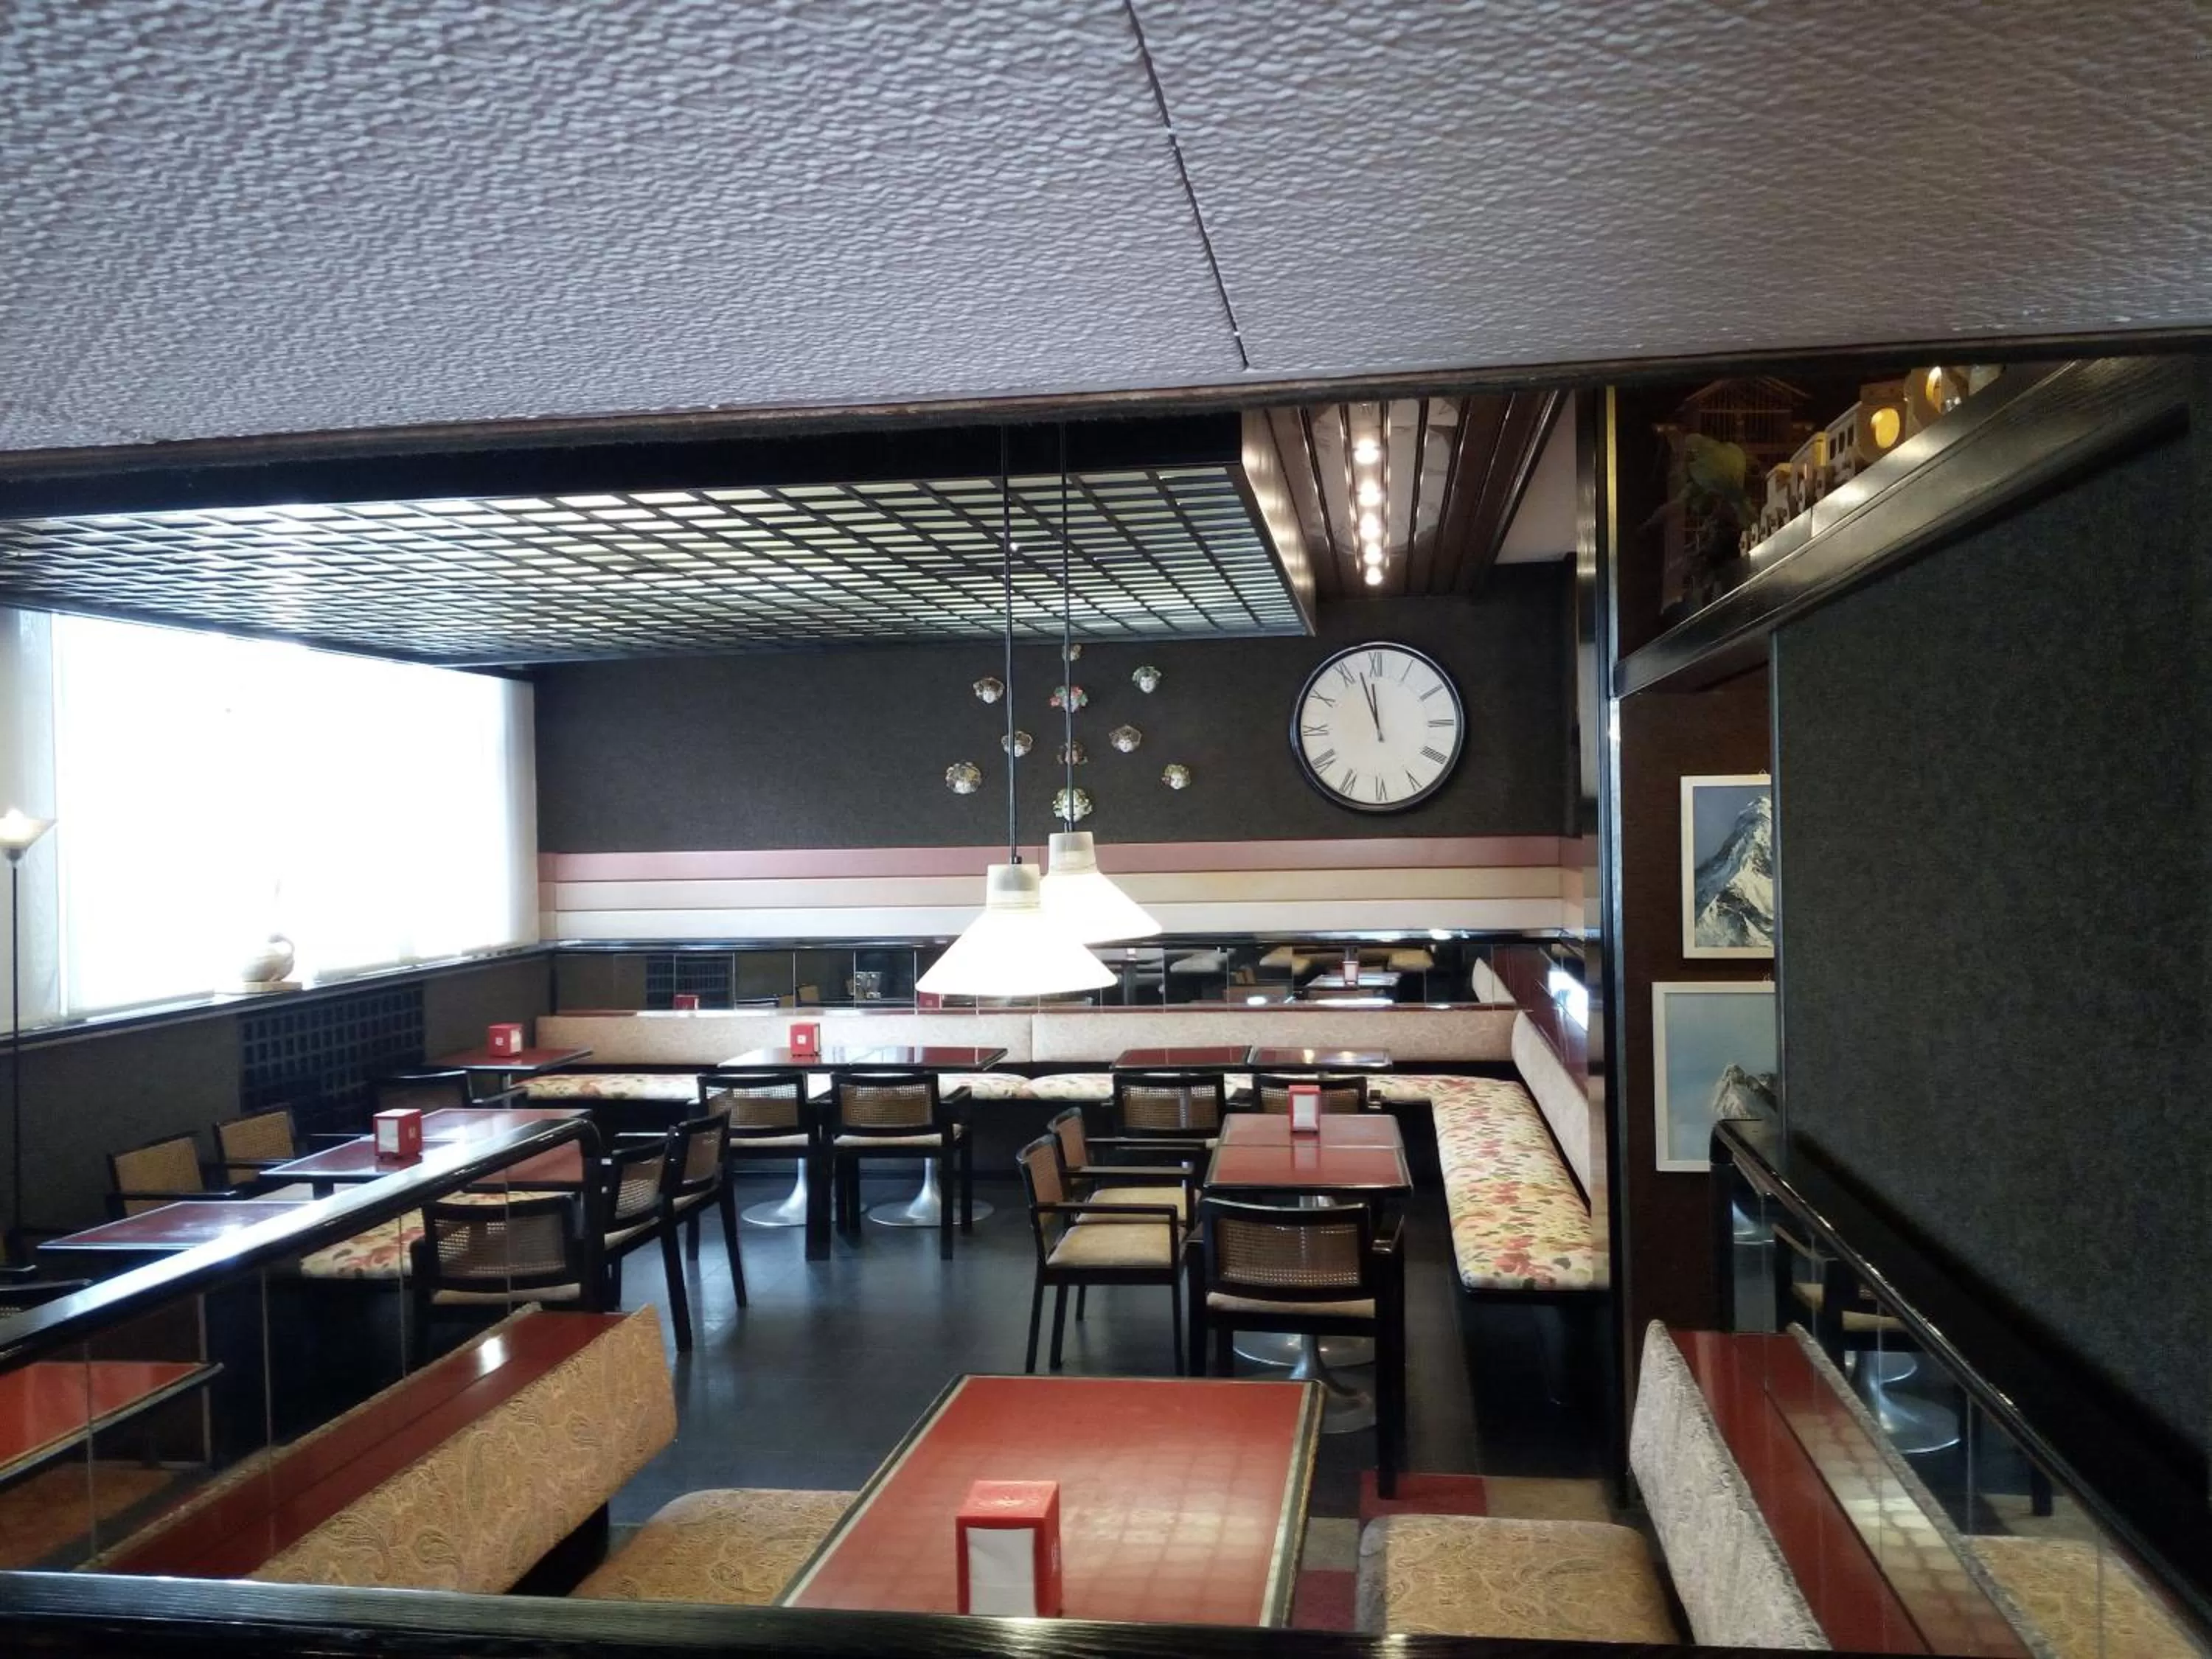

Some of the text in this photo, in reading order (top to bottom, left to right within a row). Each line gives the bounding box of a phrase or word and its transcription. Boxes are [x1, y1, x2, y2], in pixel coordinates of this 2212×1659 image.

[1334, 661, 1355, 688] XI
[1368, 651, 1383, 678] XII
[1309, 689, 1336, 708] X
[1302, 723, 1329, 737] IX
[1374, 775, 1388, 801] VI
[1405, 768, 1423, 792] V
